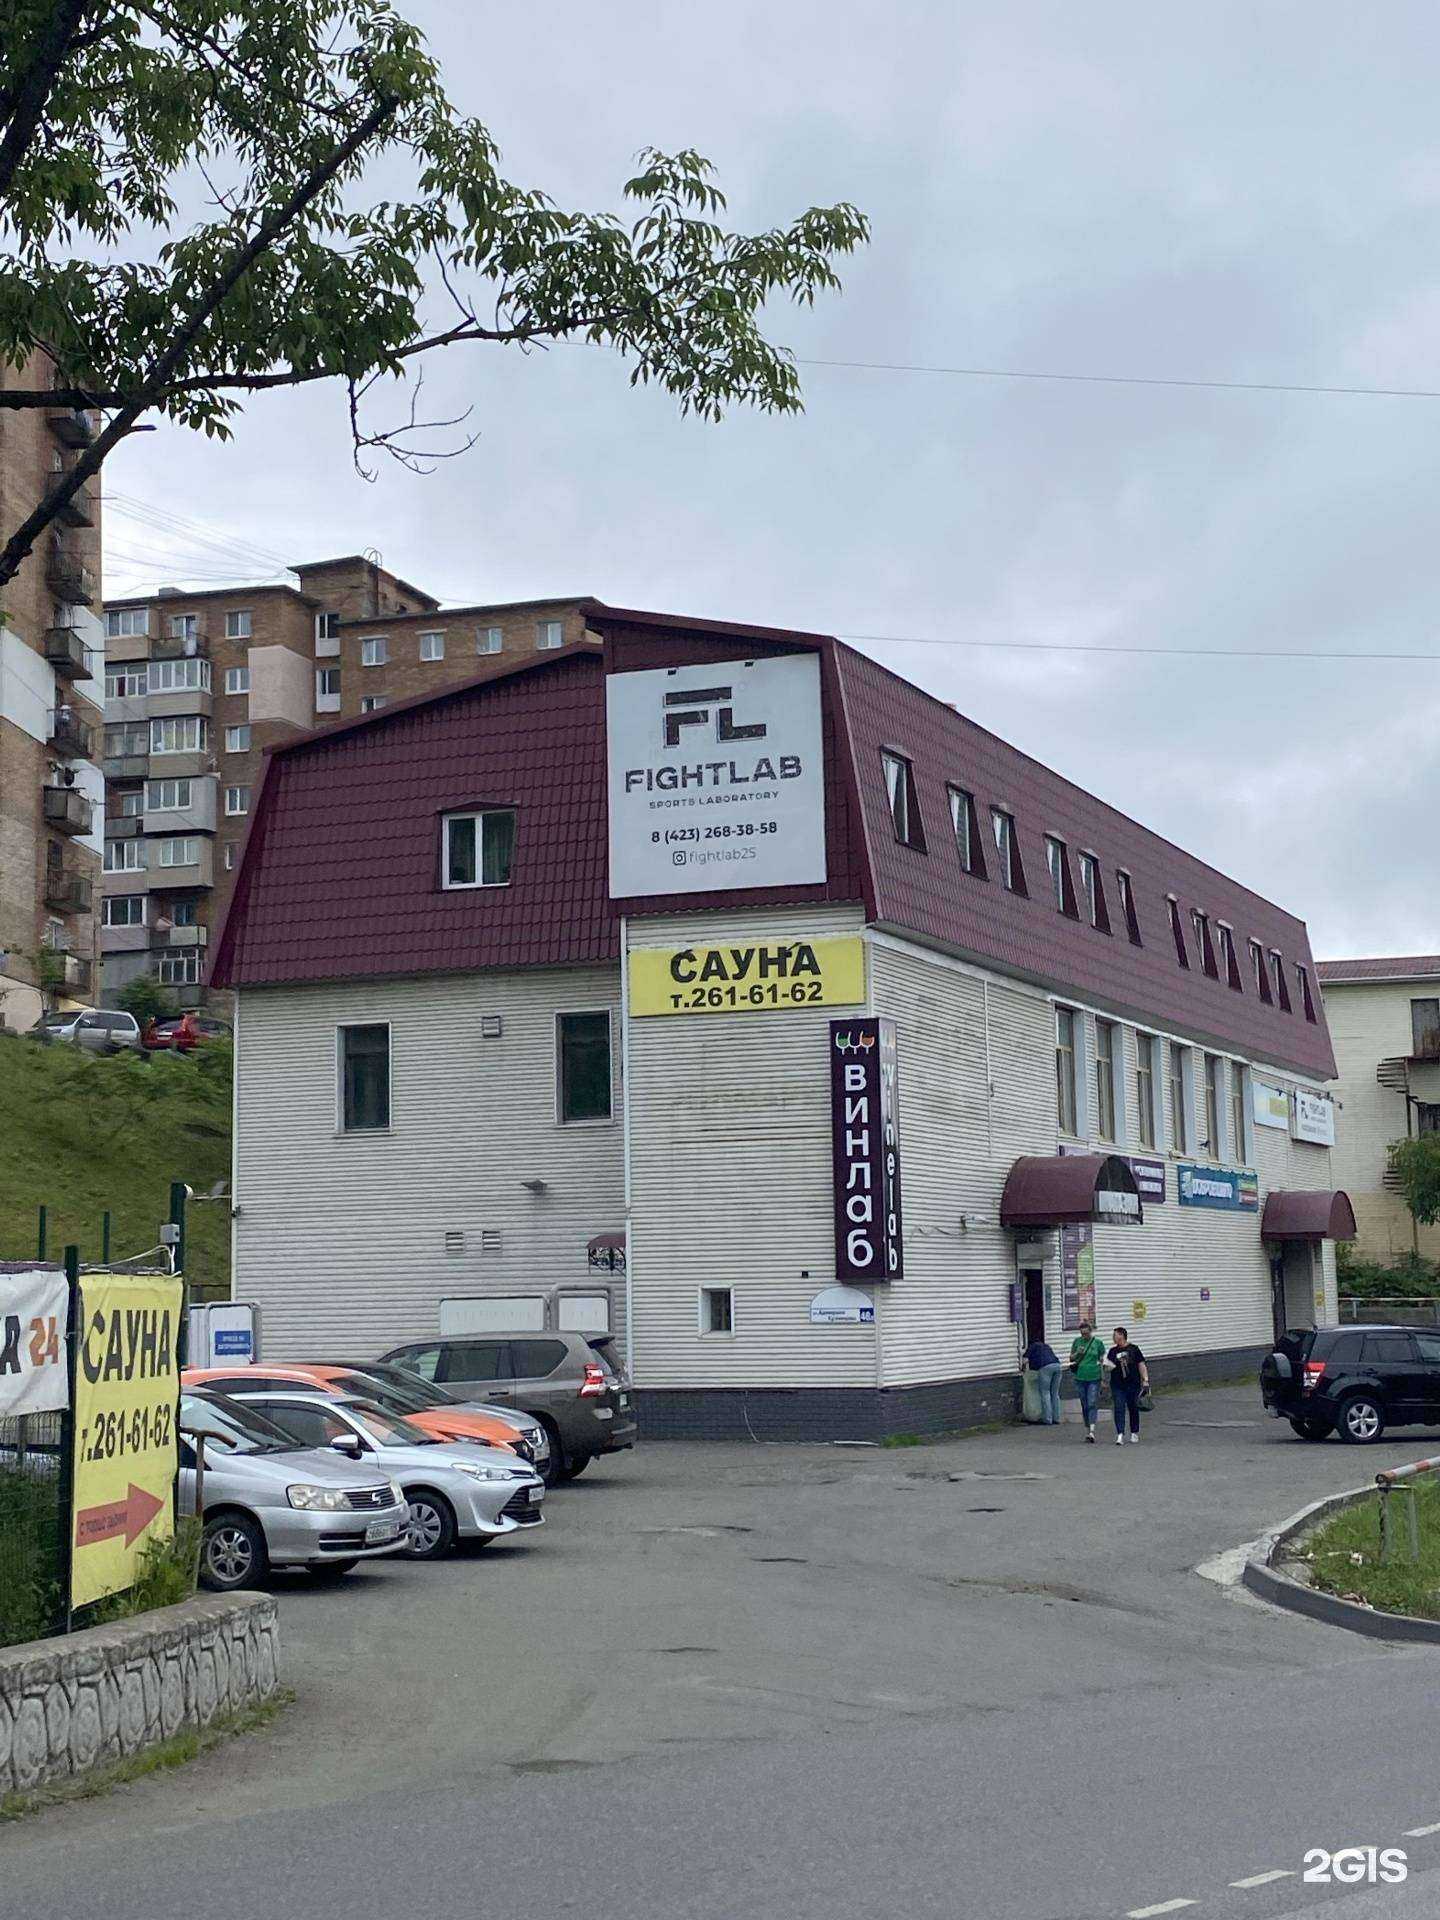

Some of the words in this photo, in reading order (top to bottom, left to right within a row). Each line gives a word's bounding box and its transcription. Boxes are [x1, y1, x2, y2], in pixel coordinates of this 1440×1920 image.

[625, 756, 802, 793] FIGHTLAB
[649, 798, 696, 810] SPORTS
[699, 791, 780, 806] LABORATORY
[651, 831, 661, 843] 8
[665, 827, 700, 845] (423)
[704, 821, 778, 839] 268-38-58
[689, 847, 757, 866] fightlab25
[669, 943, 822, 984] САУНА
[670, 981, 823, 1009] т.261-61-62
[29, 1316, 59, 1367] 24
[82, 1309, 170, 1384] САУНА
